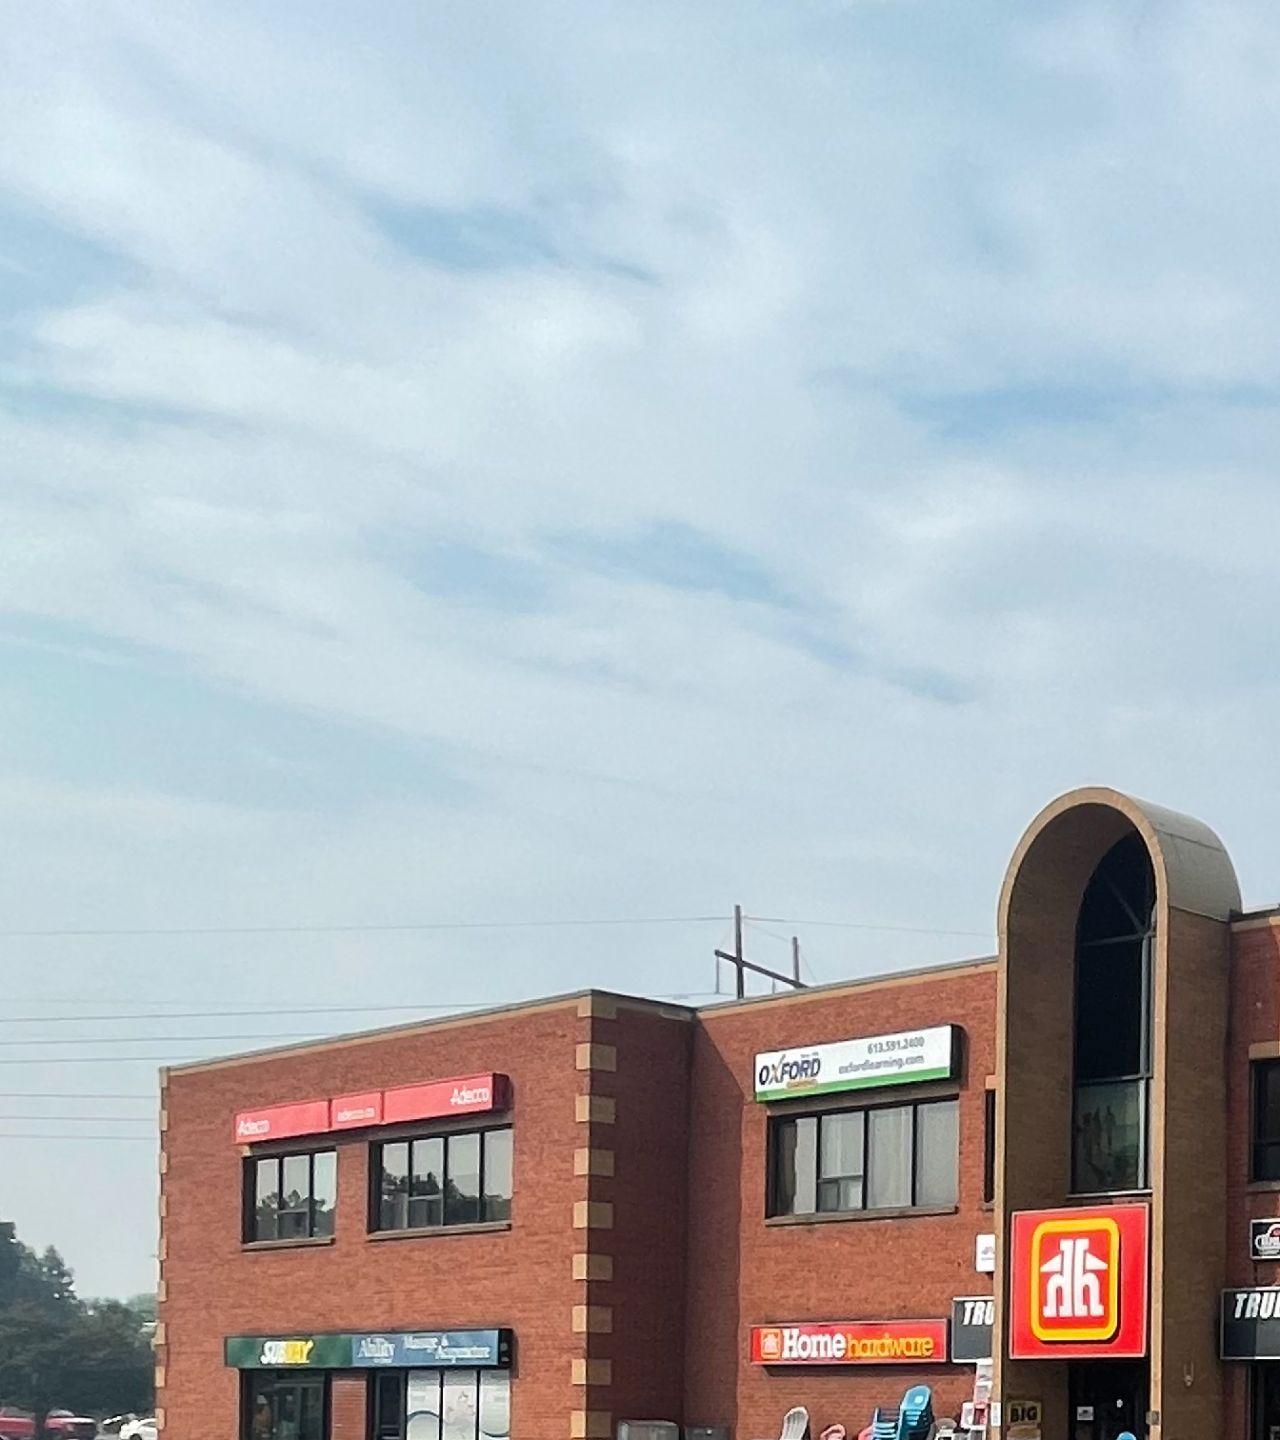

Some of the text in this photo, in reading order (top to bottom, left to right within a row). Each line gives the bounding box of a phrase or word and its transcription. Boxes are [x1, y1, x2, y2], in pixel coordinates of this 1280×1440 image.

[759, 1053, 821, 1085] OXFORD
[781, 1328, 934, 1359] Home hardware
[1010, 1406, 1038, 1423] BIG
